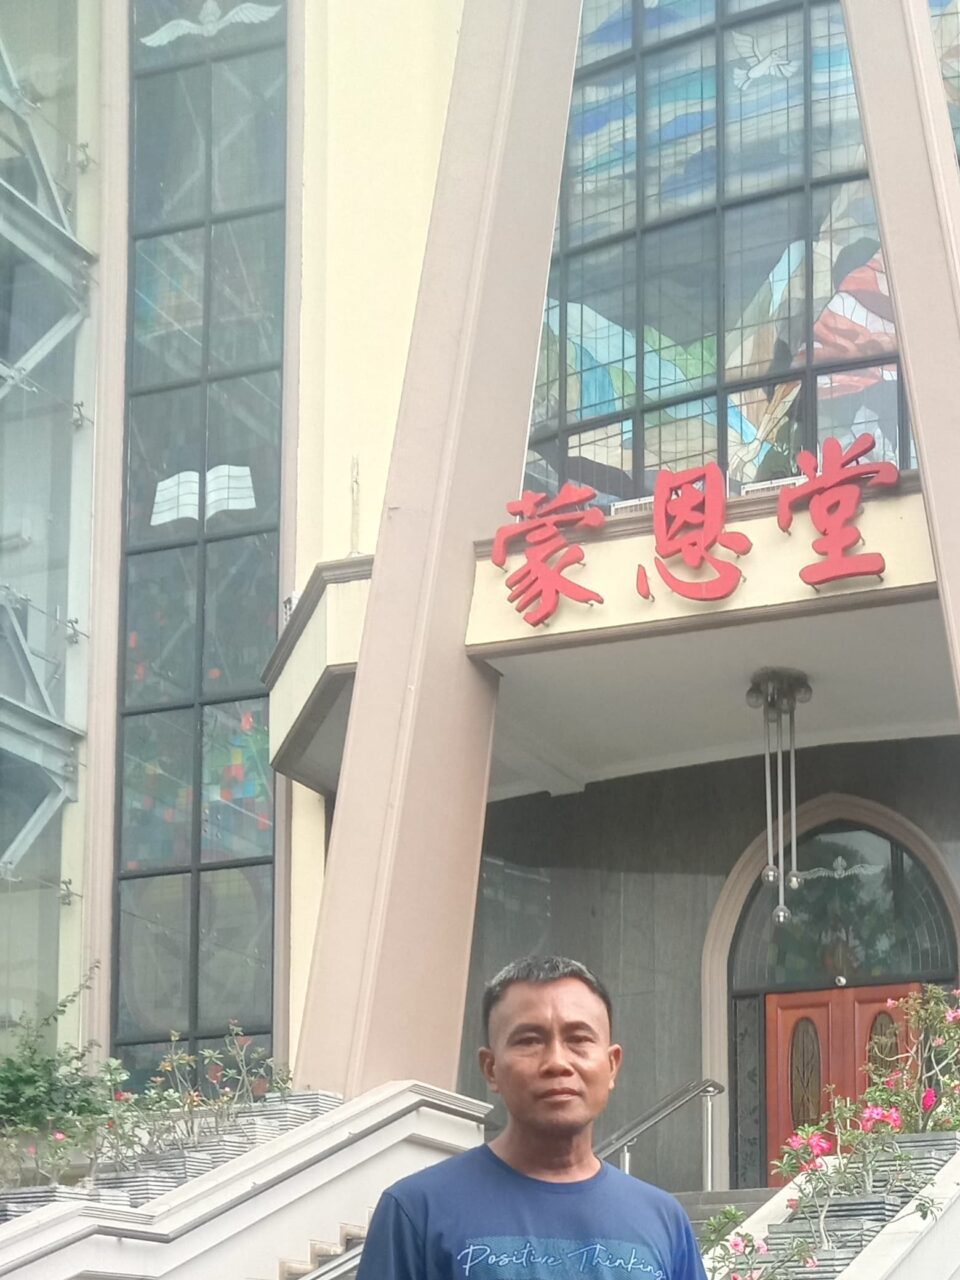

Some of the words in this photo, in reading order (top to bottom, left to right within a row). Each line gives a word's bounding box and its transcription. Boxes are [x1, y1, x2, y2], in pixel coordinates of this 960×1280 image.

[492, 433, 898, 627] 蒙恩堂
[457, 1243, 562, 1276] Positive
